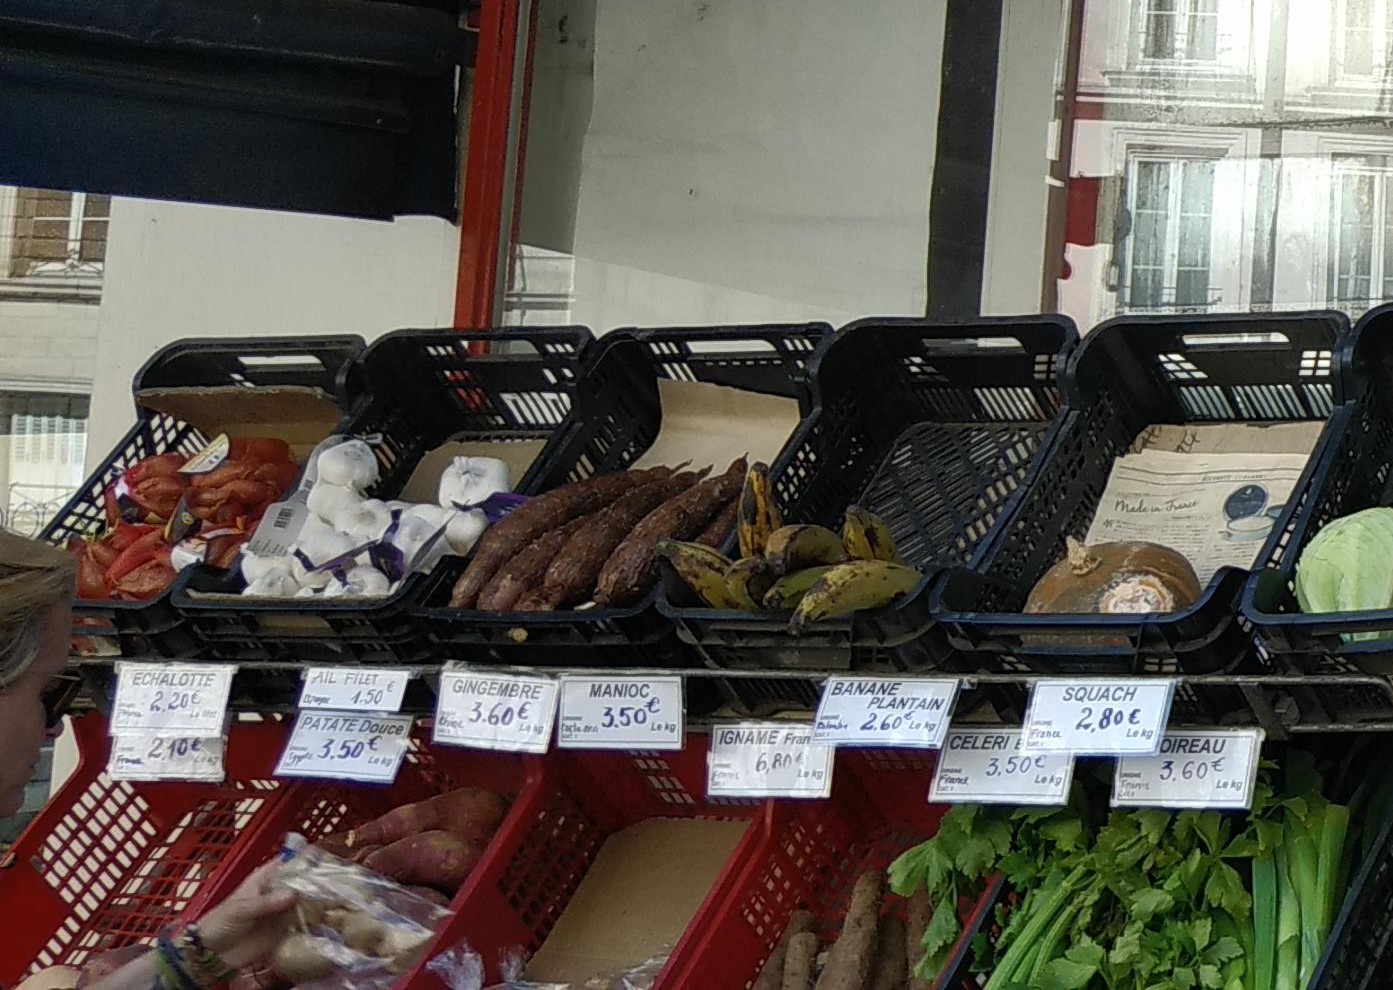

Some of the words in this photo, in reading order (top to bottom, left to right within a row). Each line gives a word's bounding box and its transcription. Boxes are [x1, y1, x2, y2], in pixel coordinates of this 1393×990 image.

[1114, 499, 1147, 513] Made
[1165, 498, 1198, 512] France
[132, 672, 216, 687] ECHALOTTE
[311, 671, 337, 684] AIL
[344, 672, 380, 685] FILET
[452, 679, 543, 699] GINGEMBRE
[589, 683, 651, 698] MANIOC
[831, 682, 902, 696] BANANE
[1062, 686, 1138, 702] SQUACH
[866, 697, 945, 710] PLANTAIN
[300, 716, 358, 732] PATATE
[358, 719, 404, 735] Douce
[719, 730, 779, 745] IGNAME
[1126, 729, 1138, 738] Le
[1141, 729, 1153, 740] kg
[949, 735, 1010, 750] CELERI
[1160, 738, 1226, 754] OIREAU
[1216, 779, 1229, 789] Le
[1230, 779, 1243, 791] kg
